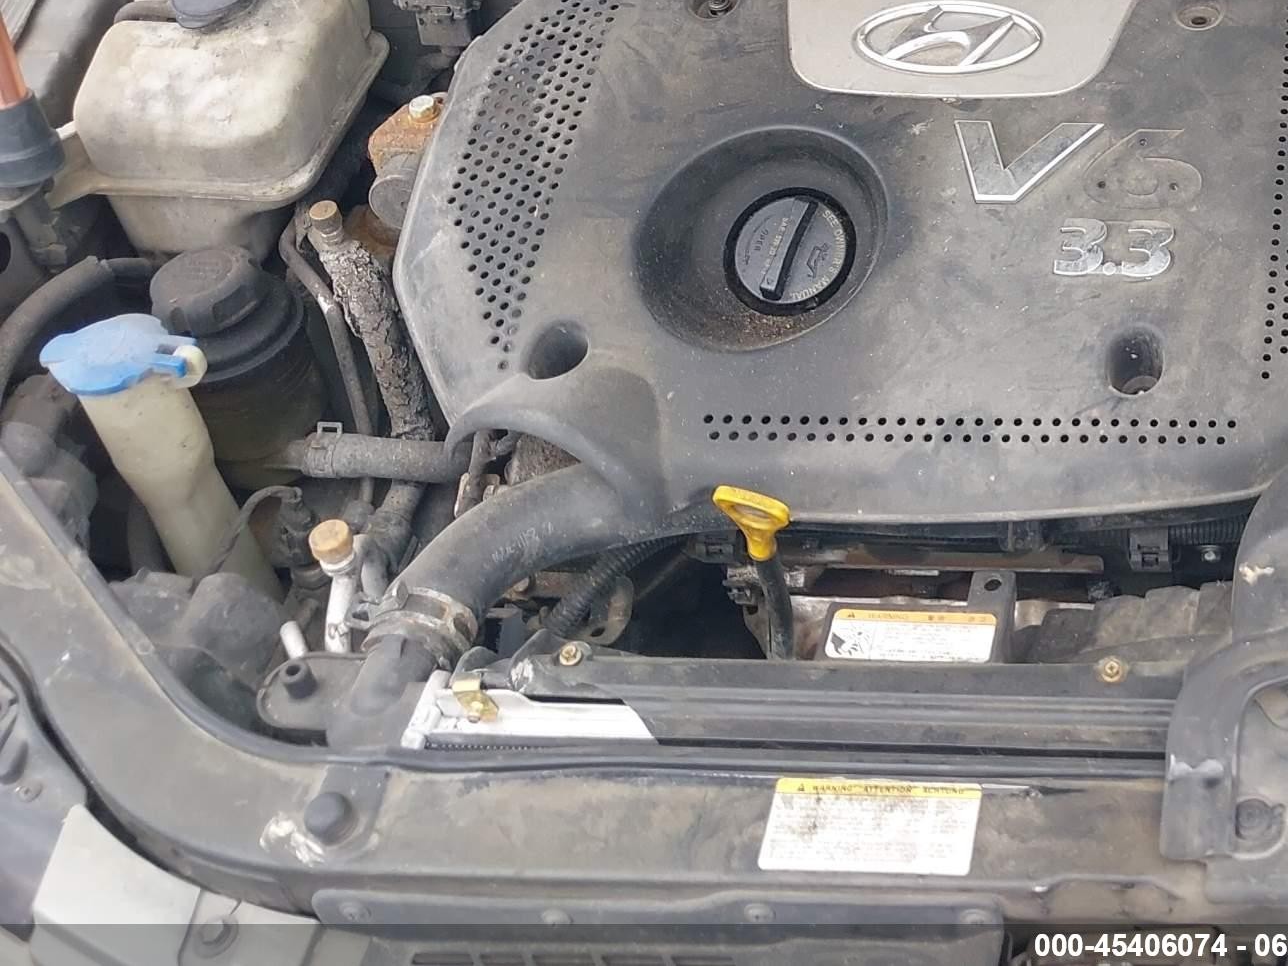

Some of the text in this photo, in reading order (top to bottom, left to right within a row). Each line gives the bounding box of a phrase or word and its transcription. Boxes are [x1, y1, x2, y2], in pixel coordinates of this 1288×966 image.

[954, 120, 1202, 210] V6
[823, 210, 839, 227] SEE
[1054, 218, 1175, 278] 3.3
[790, 275, 831, 300] MANUAL
[812, 785, 853, 793] WARNING
[863, 785, 912, 794] ATTENTION
